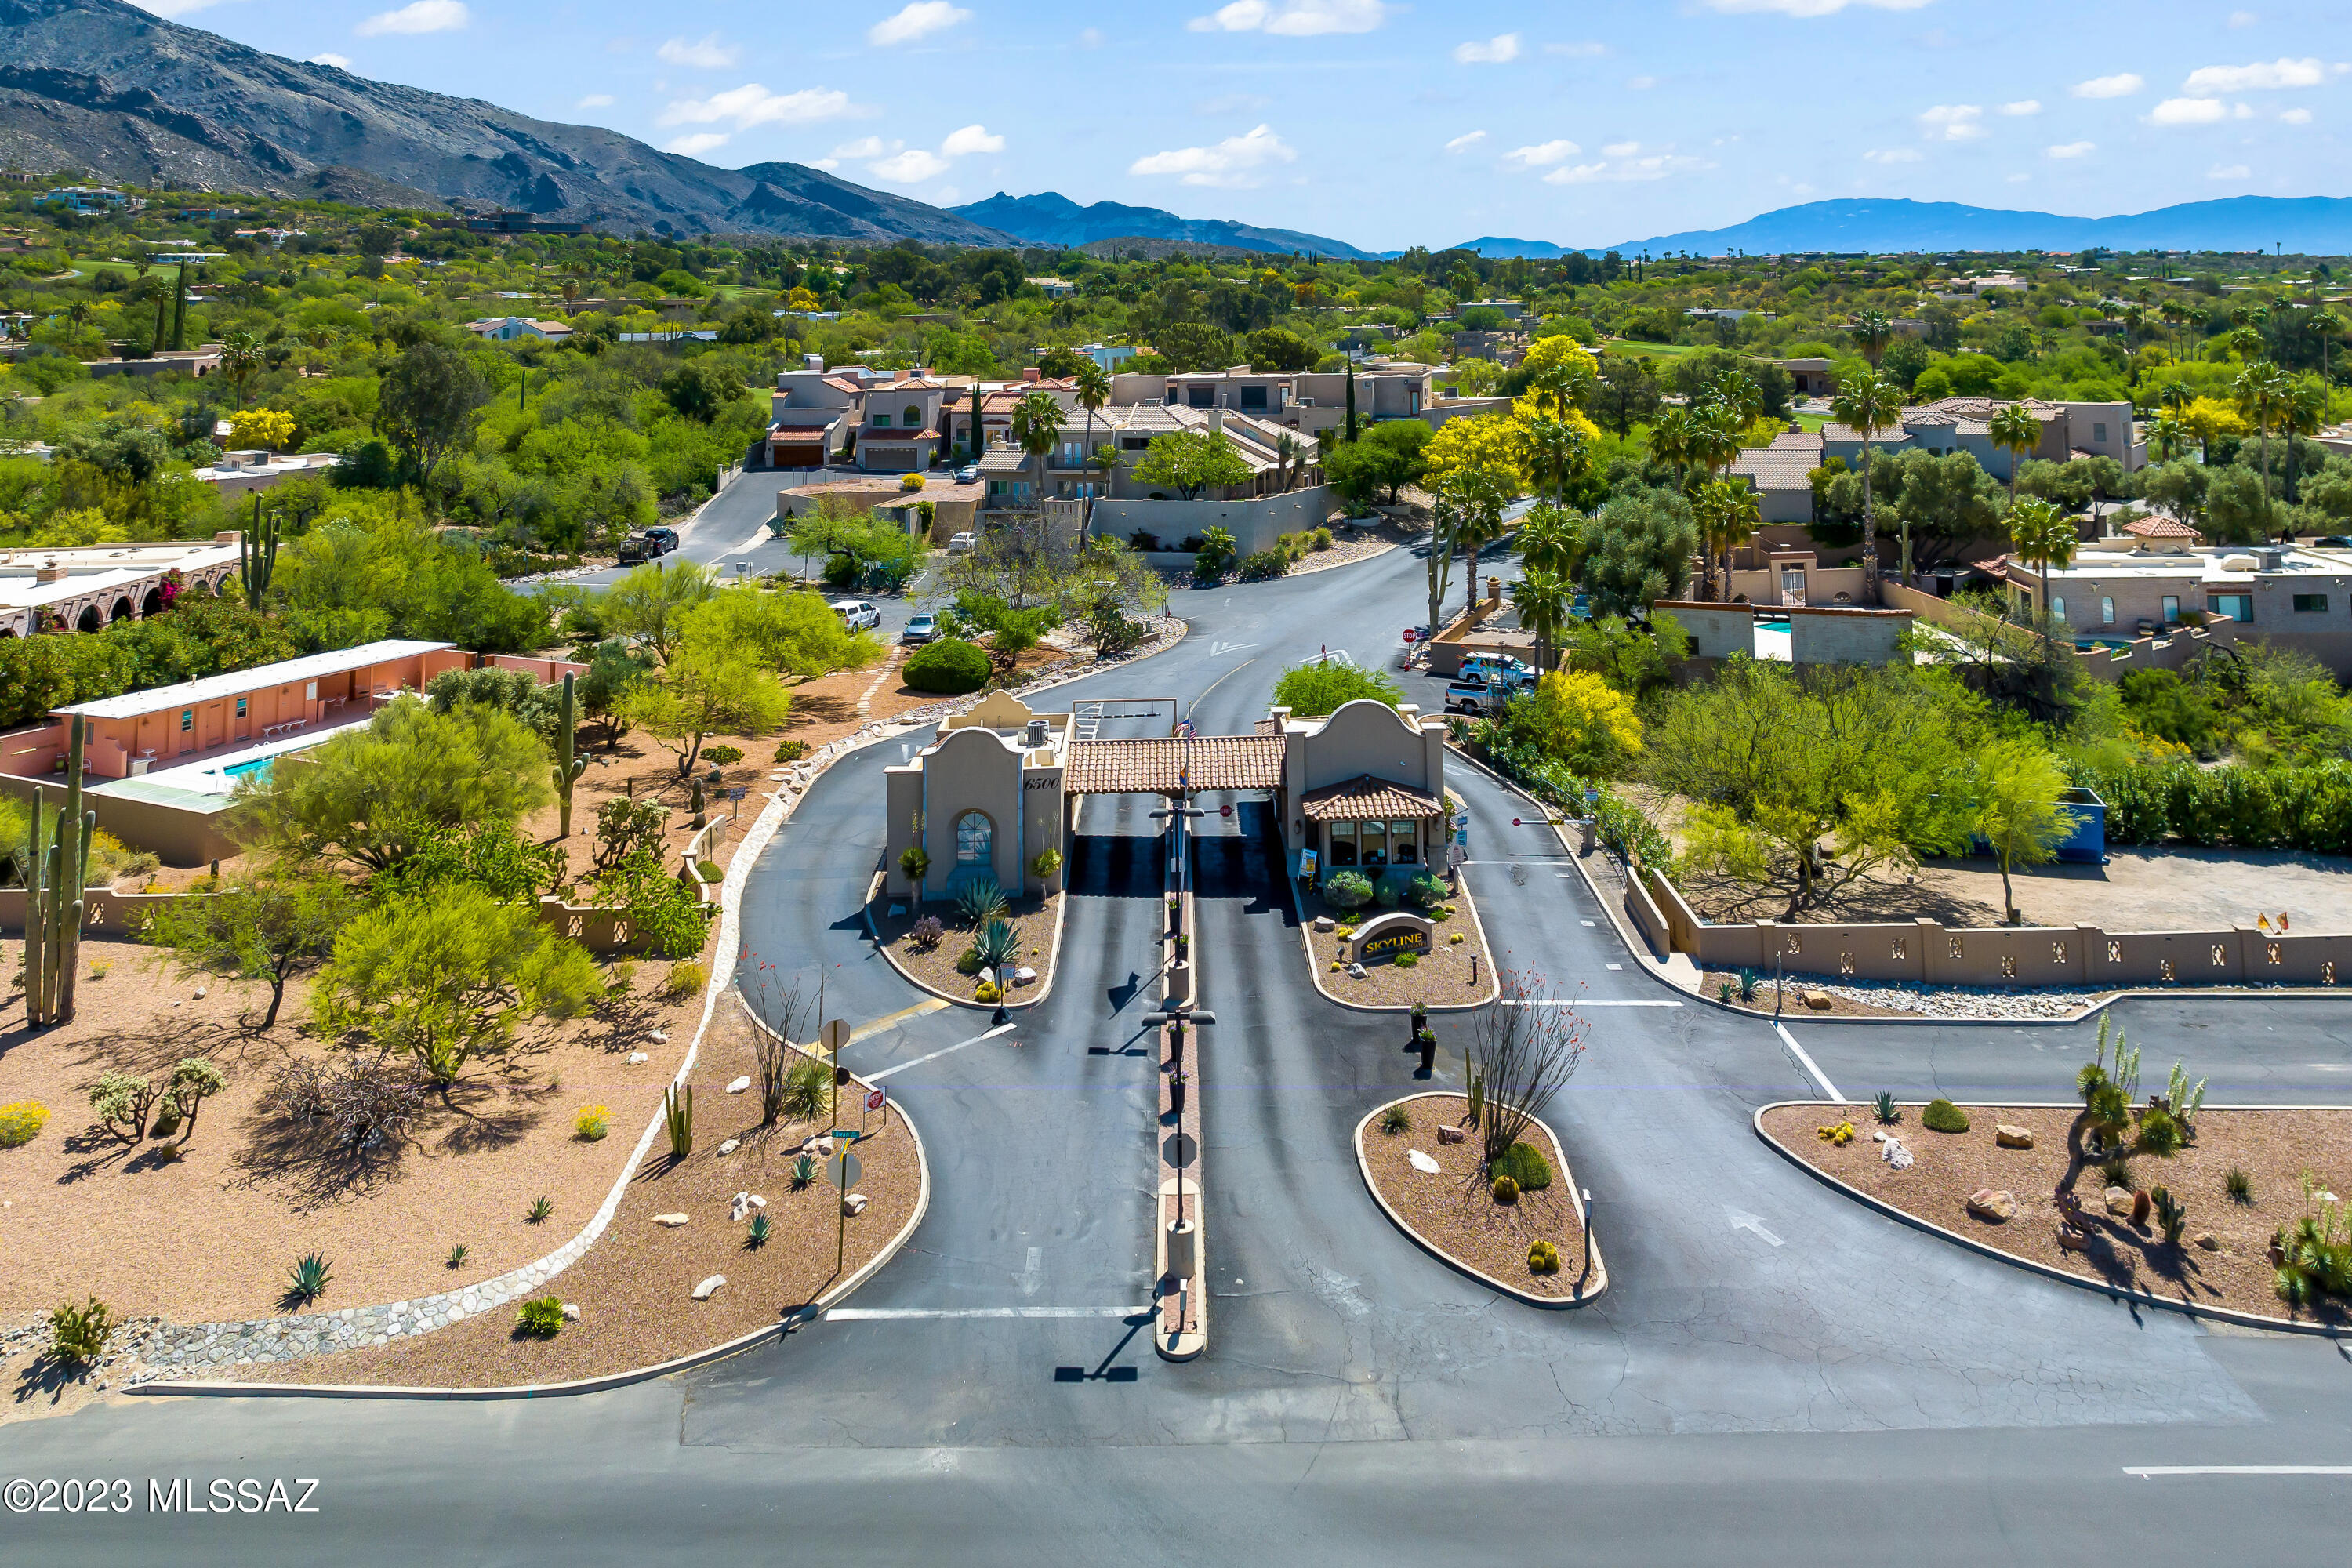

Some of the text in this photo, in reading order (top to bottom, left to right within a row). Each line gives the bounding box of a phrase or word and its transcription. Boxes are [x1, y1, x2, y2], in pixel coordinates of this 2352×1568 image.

[1025, 777, 1059, 790] 6500
[1367, 932, 1423, 953] SKYLINE
[869, 1092, 883, 1102] STOP
